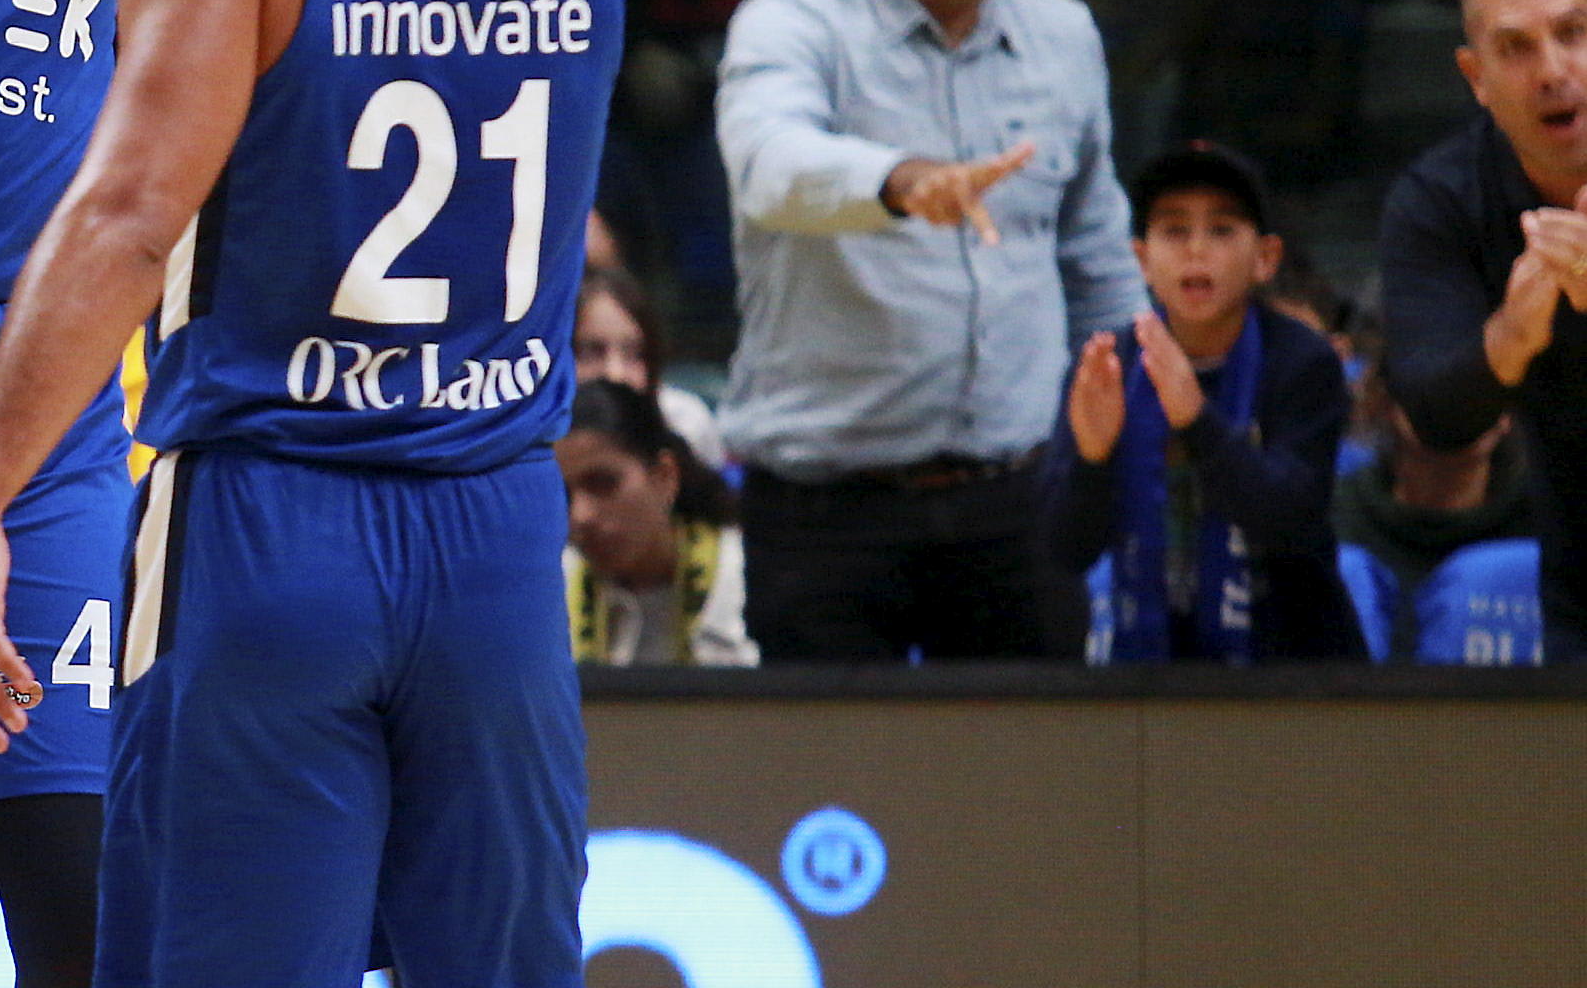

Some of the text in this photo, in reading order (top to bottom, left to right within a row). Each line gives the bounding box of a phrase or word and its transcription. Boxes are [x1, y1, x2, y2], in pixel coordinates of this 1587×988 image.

[329, 79, 551, 324] 21
[286, 336, 551, 410] ORC Land
[52, 599, 114, 709] 4
